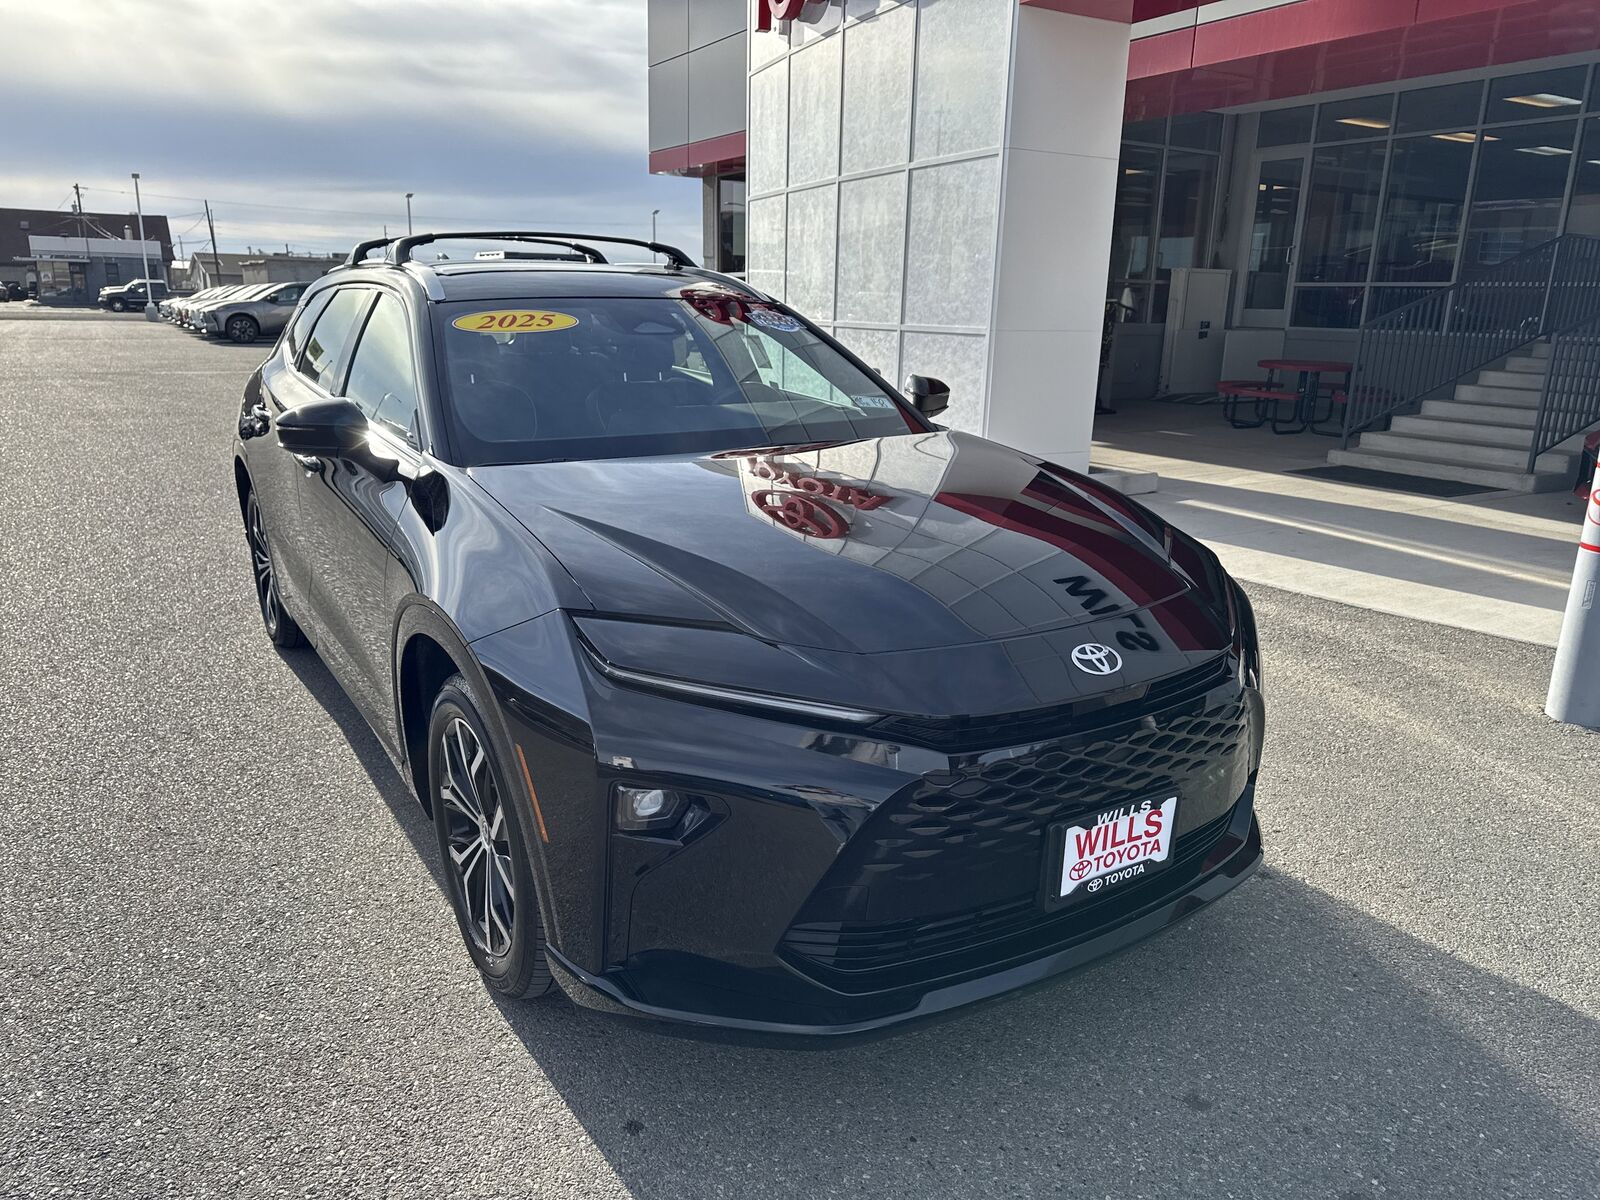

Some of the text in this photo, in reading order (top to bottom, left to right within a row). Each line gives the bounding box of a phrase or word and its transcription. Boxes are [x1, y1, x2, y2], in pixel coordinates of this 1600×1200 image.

[476, 314, 556, 330] 2025
[1097, 800, 1152, 824] WILLS
[1075, 809, 1163, 860] WILLS
[1093, 839, 1161, 872] TOYOTA
[1104, 863, 1145, 886] TOYOTA
